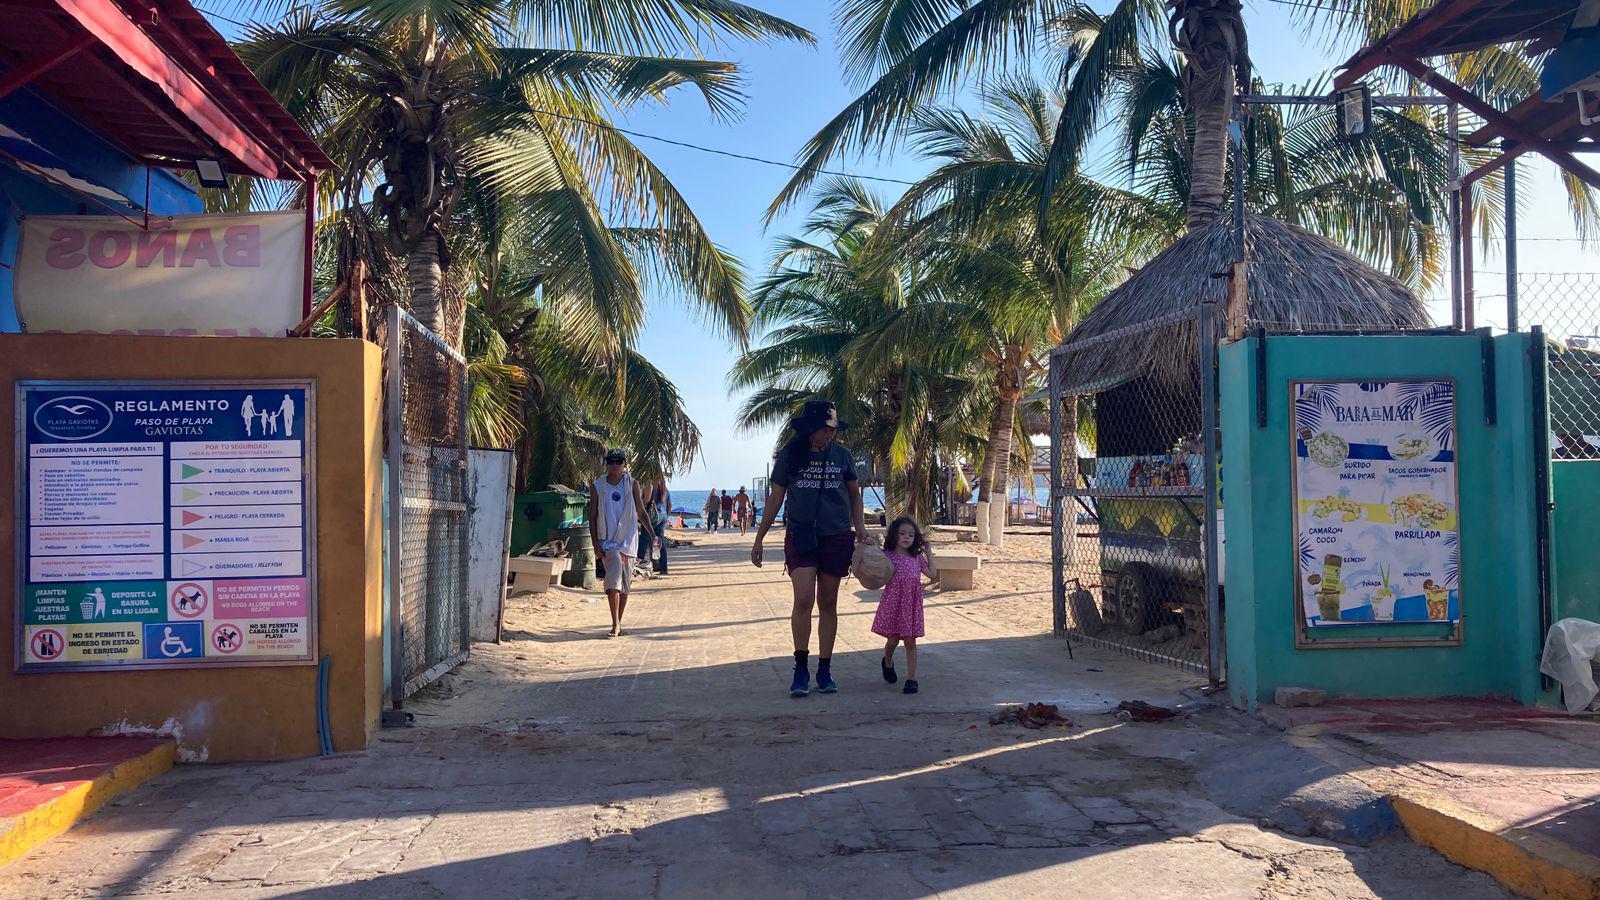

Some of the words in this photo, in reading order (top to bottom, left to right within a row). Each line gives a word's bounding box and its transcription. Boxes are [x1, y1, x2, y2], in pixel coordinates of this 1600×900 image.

[114, 400, 230, 412] REGLAMENTO
[1382, 406, 1414, 422] MAR
[145, 426, 204, 436] GAVIOTAS
[1316, 536, 1337, 544] COCO
[1394, 530, 1441, 540] PARRILLADA
